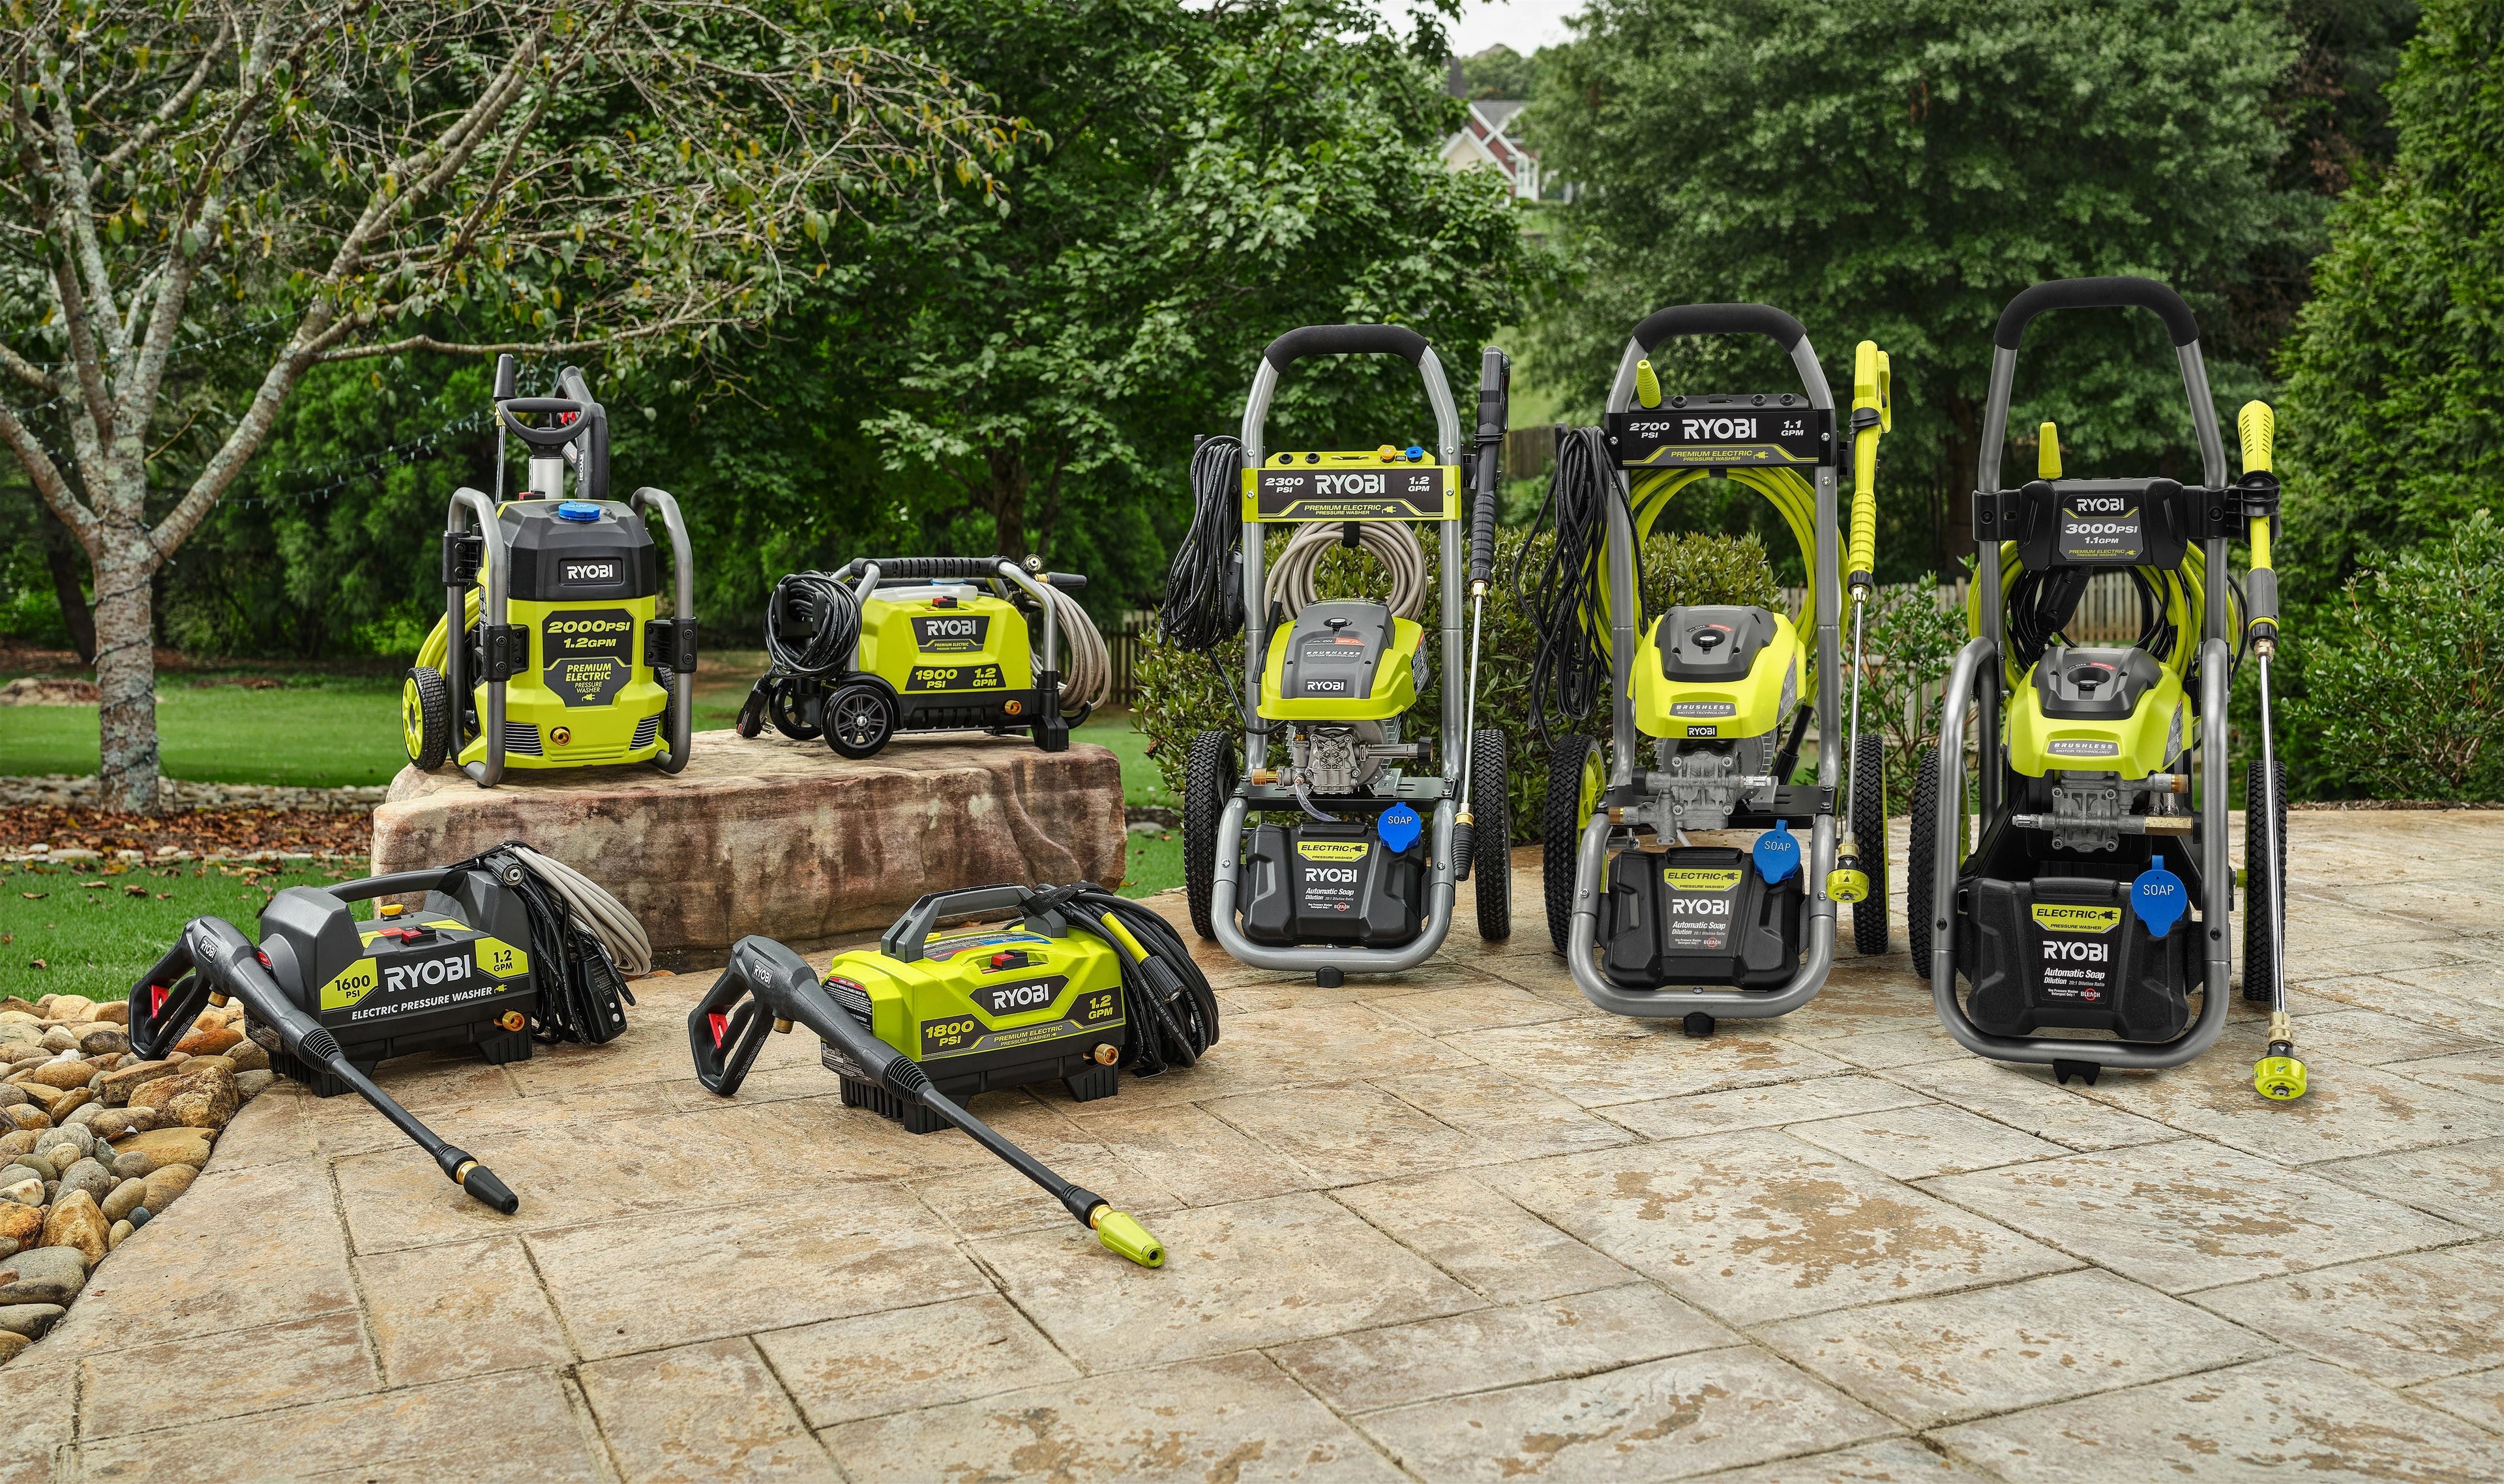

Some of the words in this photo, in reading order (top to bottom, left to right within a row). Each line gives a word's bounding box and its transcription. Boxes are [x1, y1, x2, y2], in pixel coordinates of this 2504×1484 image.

[1630, 423, 1669, 431] 2700
[1682, 419, 1756, 439] RYOBI
[1264, 477, 1304, 486] 2300
[1315, 474, 1385, 494] RYOBI
[2076, 498, 2124, 511] RYOBI
[2065, 524, 2138, 534] 3000PSI
[567, 565, 613, 579] RYOBI
[547, 620, 630, 633] 2000PSI
[926, 620, 976, 636] RYOBI
[563, 638, 616, 648] 1.2GPM
[567, 663, 612, 672] PREMIUM
[975, 668, 996, 678] 1.2
[565, 672, 611, 681] ELECTRIC
[916, 669, 958, 680] 1900
[972, 679, 997, 687] GPM
[1307, 681, 1344, 690] RYOBI
[1388, 816, 1412, 824] SOAP
[1764, 840, 1791, 852] SOAP
[1305, 868, 1358, 883] RYOBI
[1338, 888, 1354, 897] Soap
[2143, 884, 2174, 896] SOAP
[1672, 898, 1730, 915] RYOBI
[2036, 908, 2097, 919] ELECTRIC
[1673, 921, 1708, 929] Automatic
[1708, 921, 1726, 930] Soap
[200, 939, 217, 959] RYOBI
[2042, 940, 2108, 962] RYOBI
[493, 949, 512, 964] 1.2
[384, 954, 471, 992] RYOBI
[493, 961, 513, 972] GPM
[754, 964, 772, 985] RYOBI
[2044, 967, 2085, 977] Automatic
[2085, 970, 2105, 981] Soap
[335, 974, 370, 992] 1600
[346, 989, 360, 999] PSI
[992, 983, 1049, 1009] RYOBI
[351, 1003, 398, 1021] ELECTRIC
[401, 994, 450, 1012] PRESSURE
[451, 987, 492, 1002] WASHER
[1090, 994, 1112, 1009] 1.2
[1190, 1001, 1199, 1012] AWAY
[1088, 1007, 1113, 1020] GPM
[925, 1020, 975, 1038] 1800
[994, 1030, 1028, 1043] PREMIUM
[1030, 1025, 1063, 1036] ELECTRIC
[939, 1036, 961, 1046] PSI
[1000, 1037, 1028, 1046] PRESSURE
[1028, 1033, 1051, 1043] WASHER
